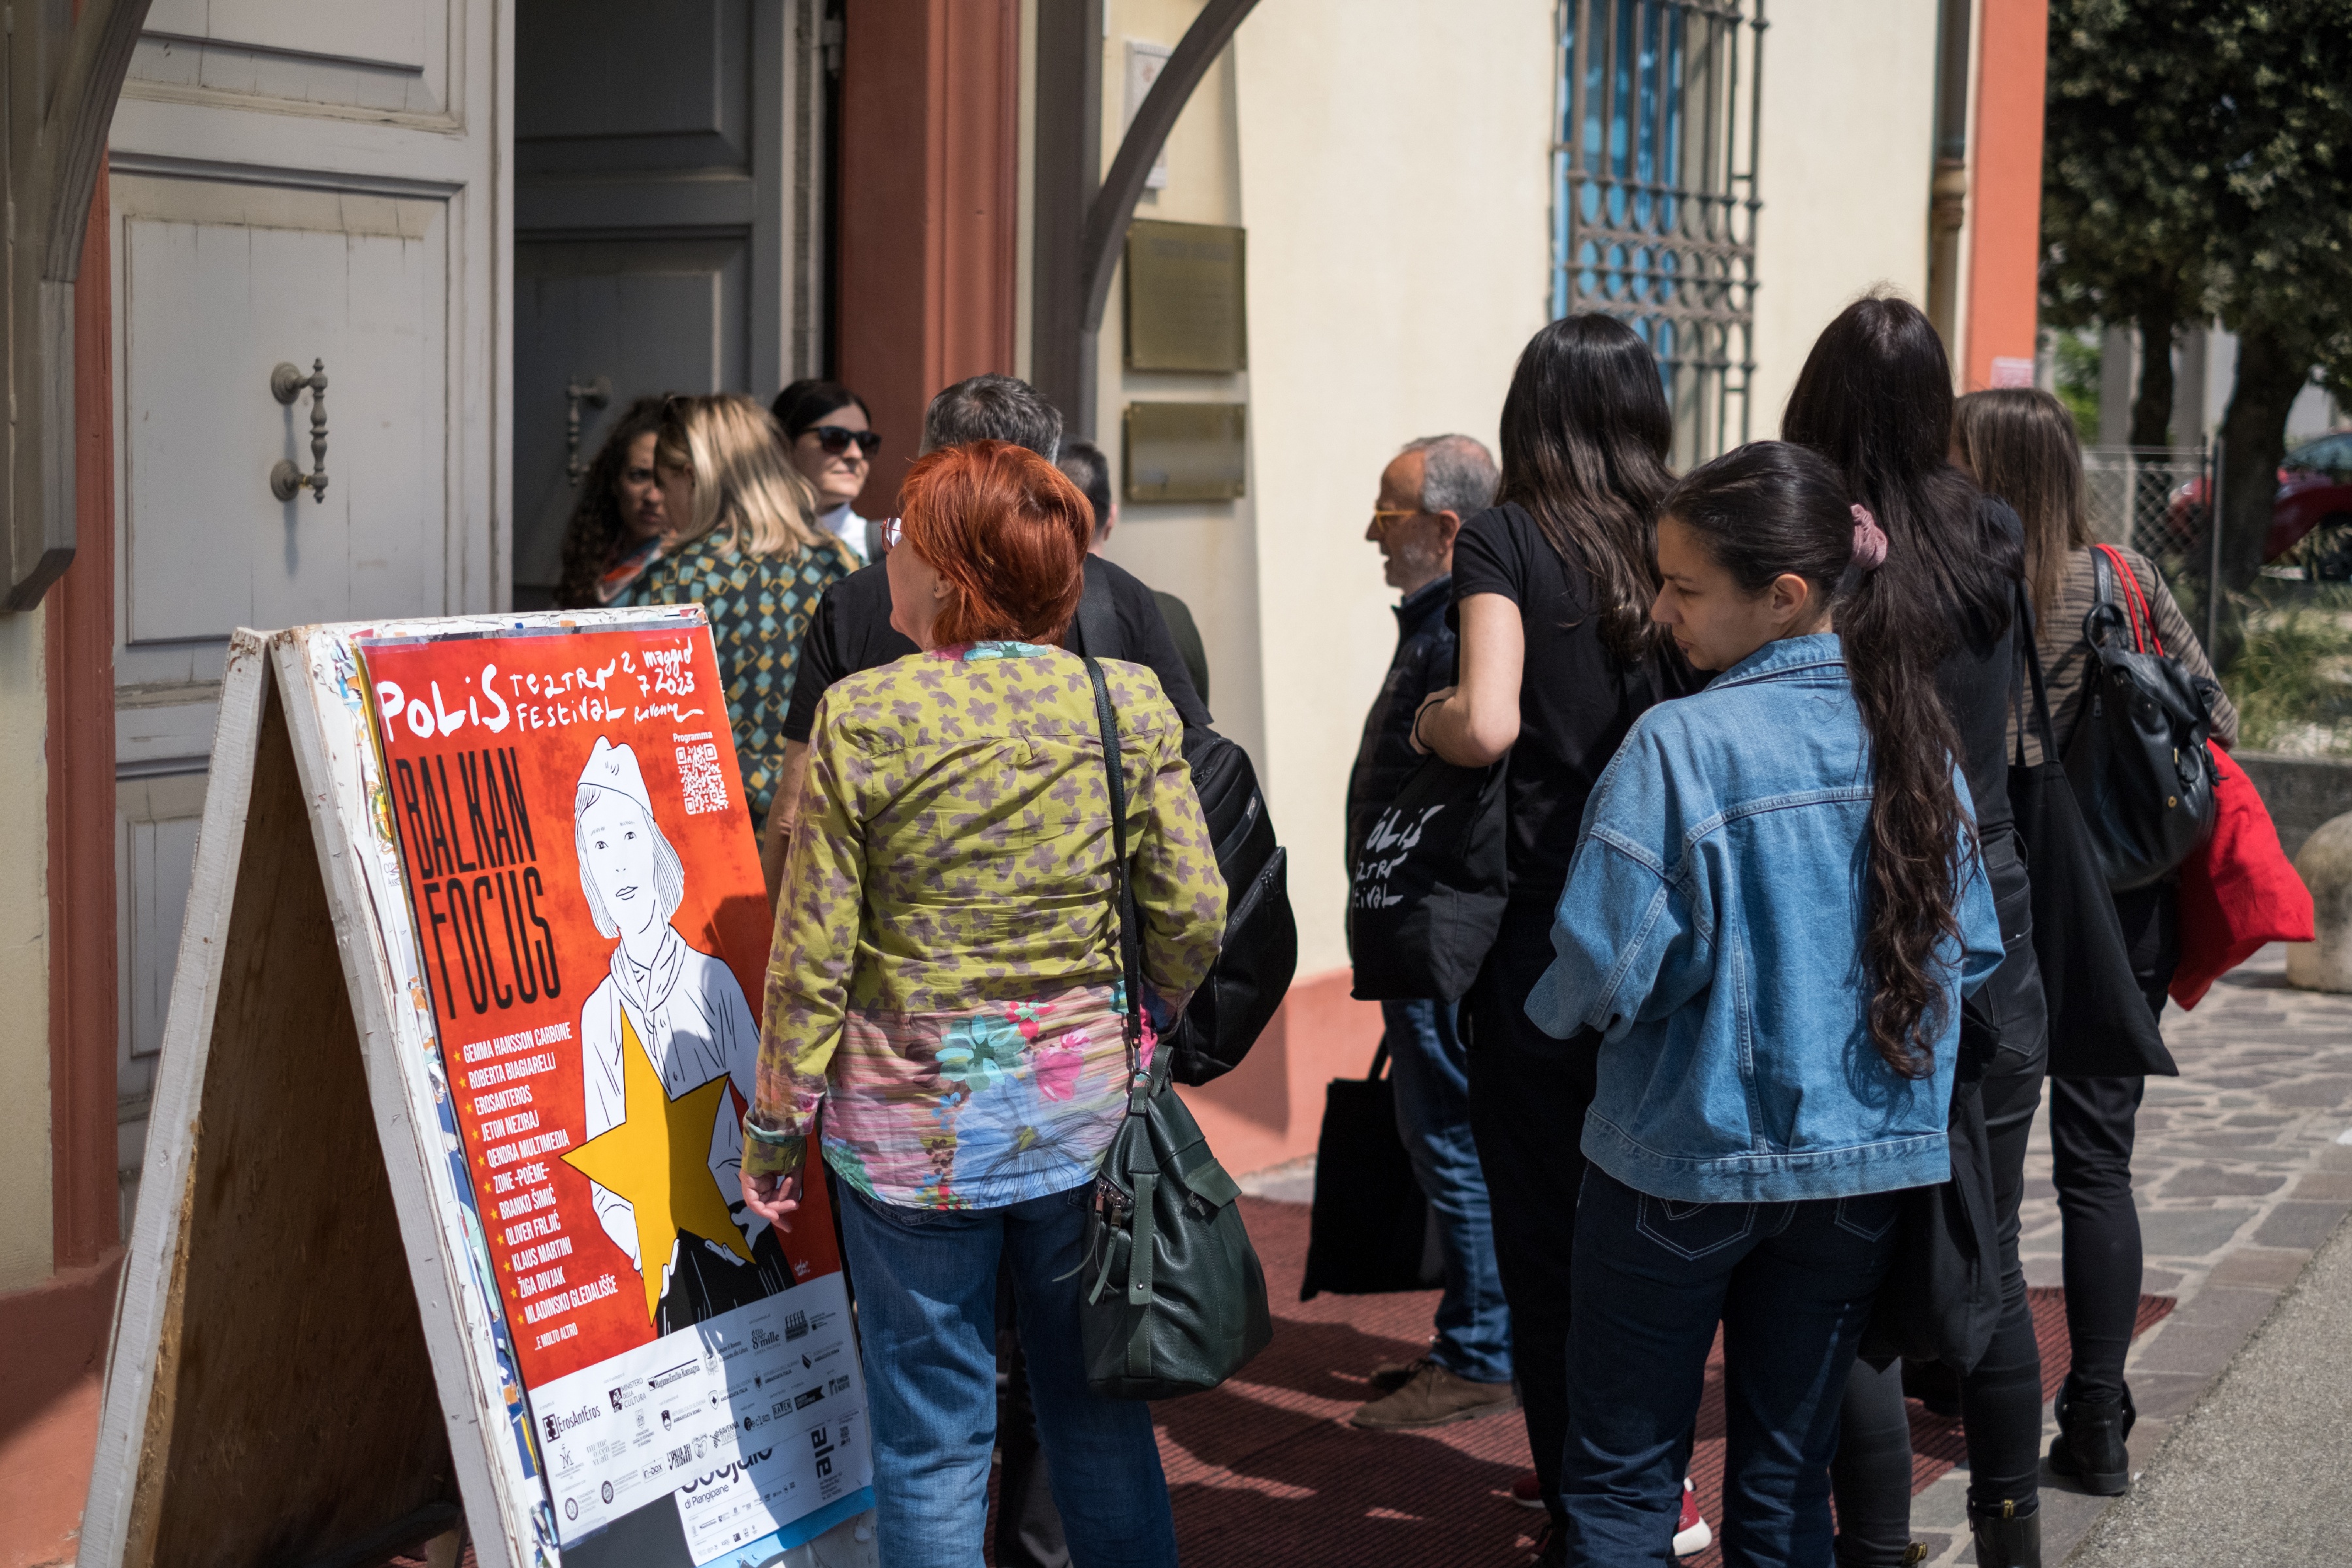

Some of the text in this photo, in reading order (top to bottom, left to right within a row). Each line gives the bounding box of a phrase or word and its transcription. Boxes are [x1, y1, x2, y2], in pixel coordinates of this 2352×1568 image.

[621, 636, 693, 677] 2 maggio
[636, 667, 695, 697] 7 2023
[672, 729, 713, 743] Programma
[396, 746, 536, 880] BALKAN
[423, 866, 561, 1019] FOCUS
[463, 1021, 572, 1063] GEMMA HANSSON CARBONE
[467, 1052, 557, 1089] ROBERTA BIAGIARELLI
[474, 1085, 533, 1116] EROSANTEROS
[480, 1109, 540, 1141] JETON NEZIRAJ
[486, 1128, 570, 1169] QENDRA MULTIMEDIA
[492, 1162, 550, 1194] ZONE -POÈME-
[498, 1183, 557, 1220] BRANKO ŠIMIĆ
[505, 1209, 561, 1247] OLIVER FRLJIĆ
[511, 1235, 572, 1272] KLAUS MARTINI
[517, 1266, 566, 1299] ŽIGA DIVJAK
[524, 1273, 618, 1324] MLADINSKO GLEDALIŠČE
[540, 1329, 561, 1348] MOLTO
[559, 1322, 578, 1341] ALTRO
[751, 1335, 759, 1350] 8
[759, 1331, 780, 1347] mille
[621, 1377, 644, 1392] MINISTERO
[622, 1390, 634, 1399] DELLA
[623, 1392, 647, 1409] CULTURA
[557, 1405, 601, 1432] ErosAntEros
[718, 1420, 740, 1435] RAVENNA
[685, 1484, 730, 1509] di Piangipane
